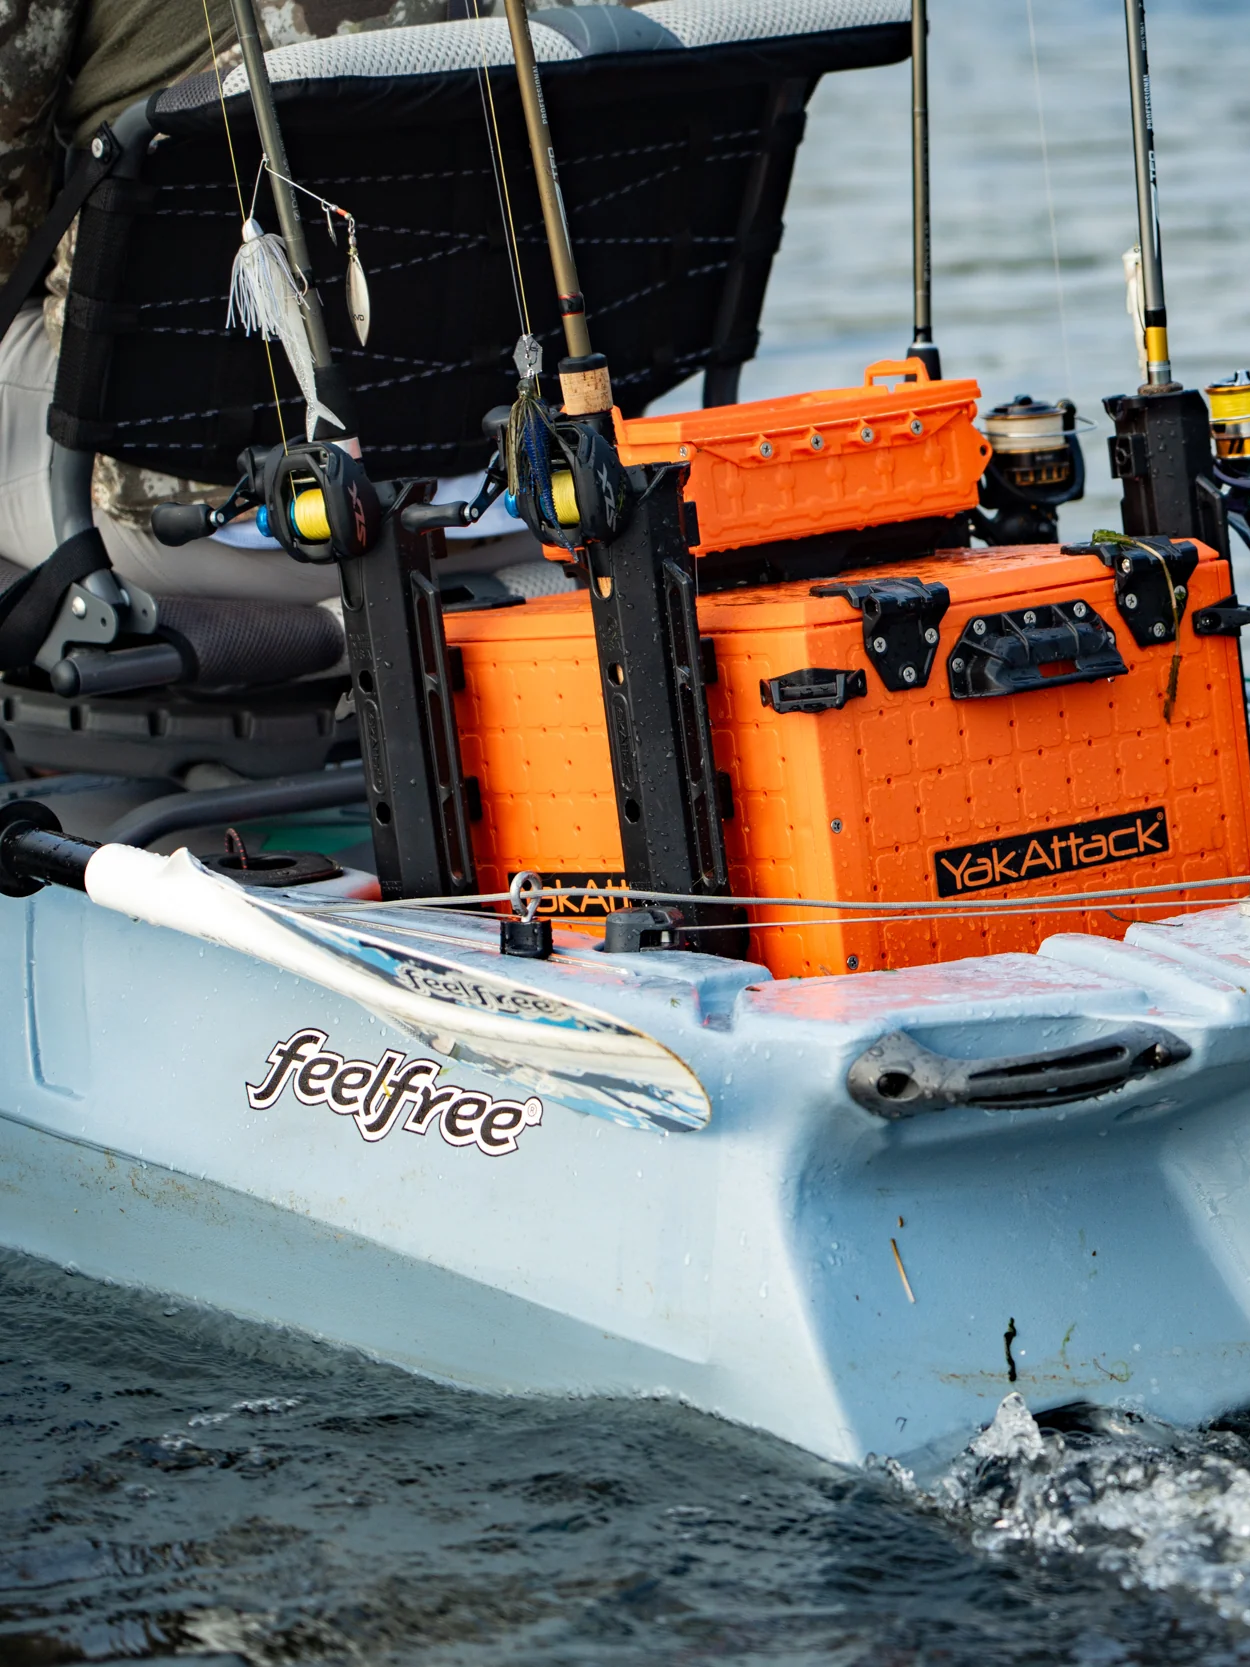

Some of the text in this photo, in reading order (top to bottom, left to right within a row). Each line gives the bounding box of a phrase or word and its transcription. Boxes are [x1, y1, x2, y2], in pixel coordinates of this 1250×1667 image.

[532, 65, 548, 125] PROFESSIONAL
[1142, 74, 1153, 130] PROFESSIONAL
[347, 479, 367, 548] SLX
[596, 462, 617, 533] SLX
[940, 817, 1163, 891] YakAttack
[401, 965, 555, 1016] feelfree
[247, 1029, 524, 1156] feelfree
